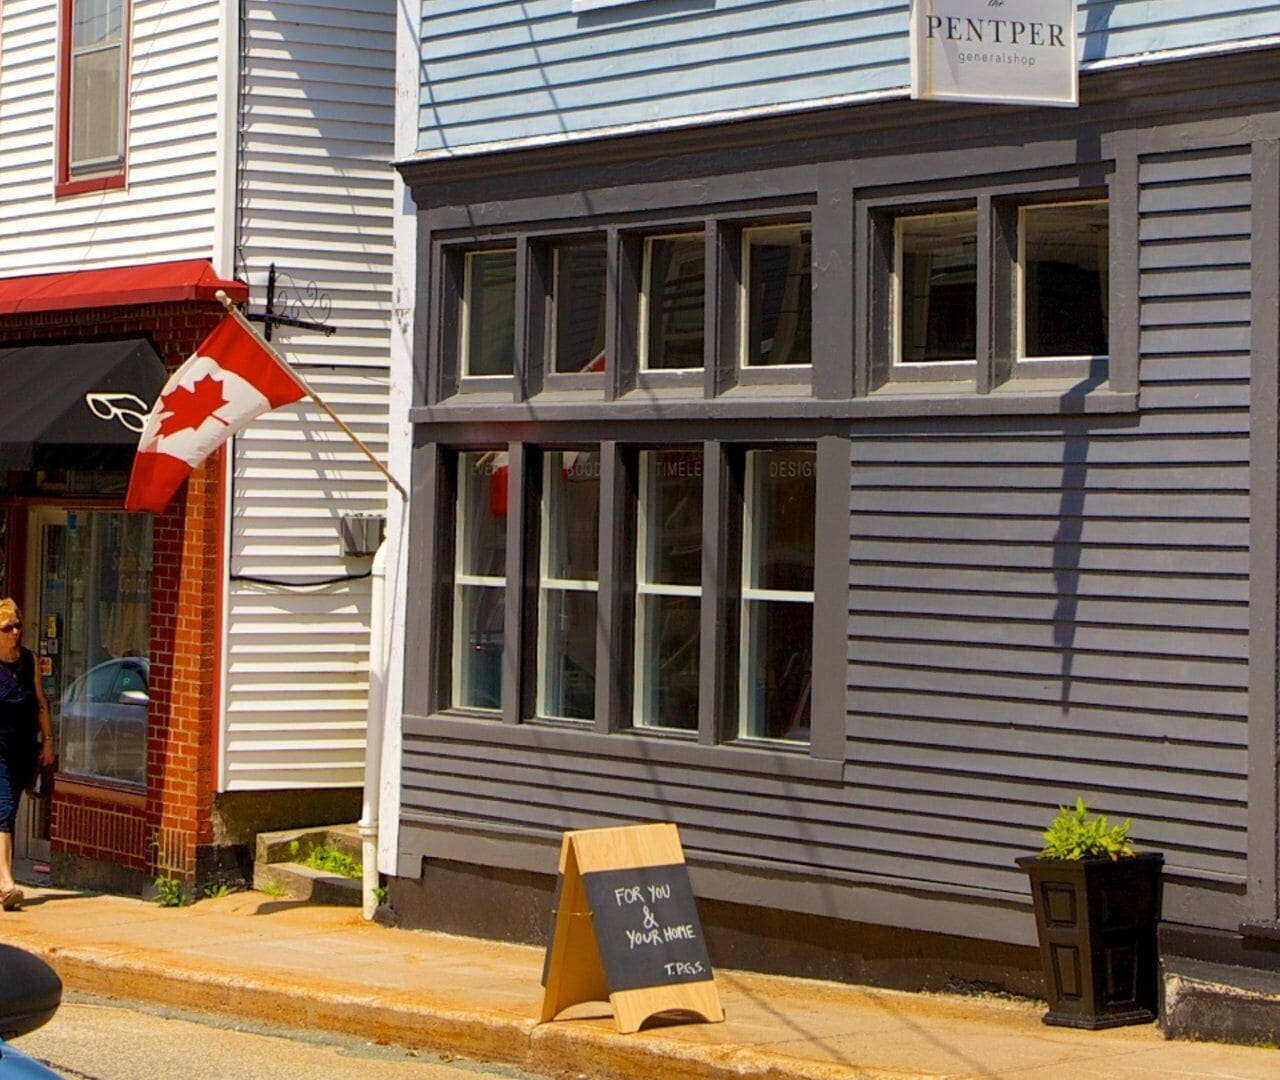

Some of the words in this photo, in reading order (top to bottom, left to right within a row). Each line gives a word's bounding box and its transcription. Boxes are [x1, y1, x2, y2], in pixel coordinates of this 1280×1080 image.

[926, 14, 1065, 47] PENTPER
[958, 51, 1036, 66] generalshop
[770, 460, 816, 478] DESIG
[614, 886, 645, 907] FOR
[647, 884, 671, 904] YOU
[643, 905, 659, 929] &
[625, 928, 663, 950] YOUR
[663, 924, 696, 942] HOME
